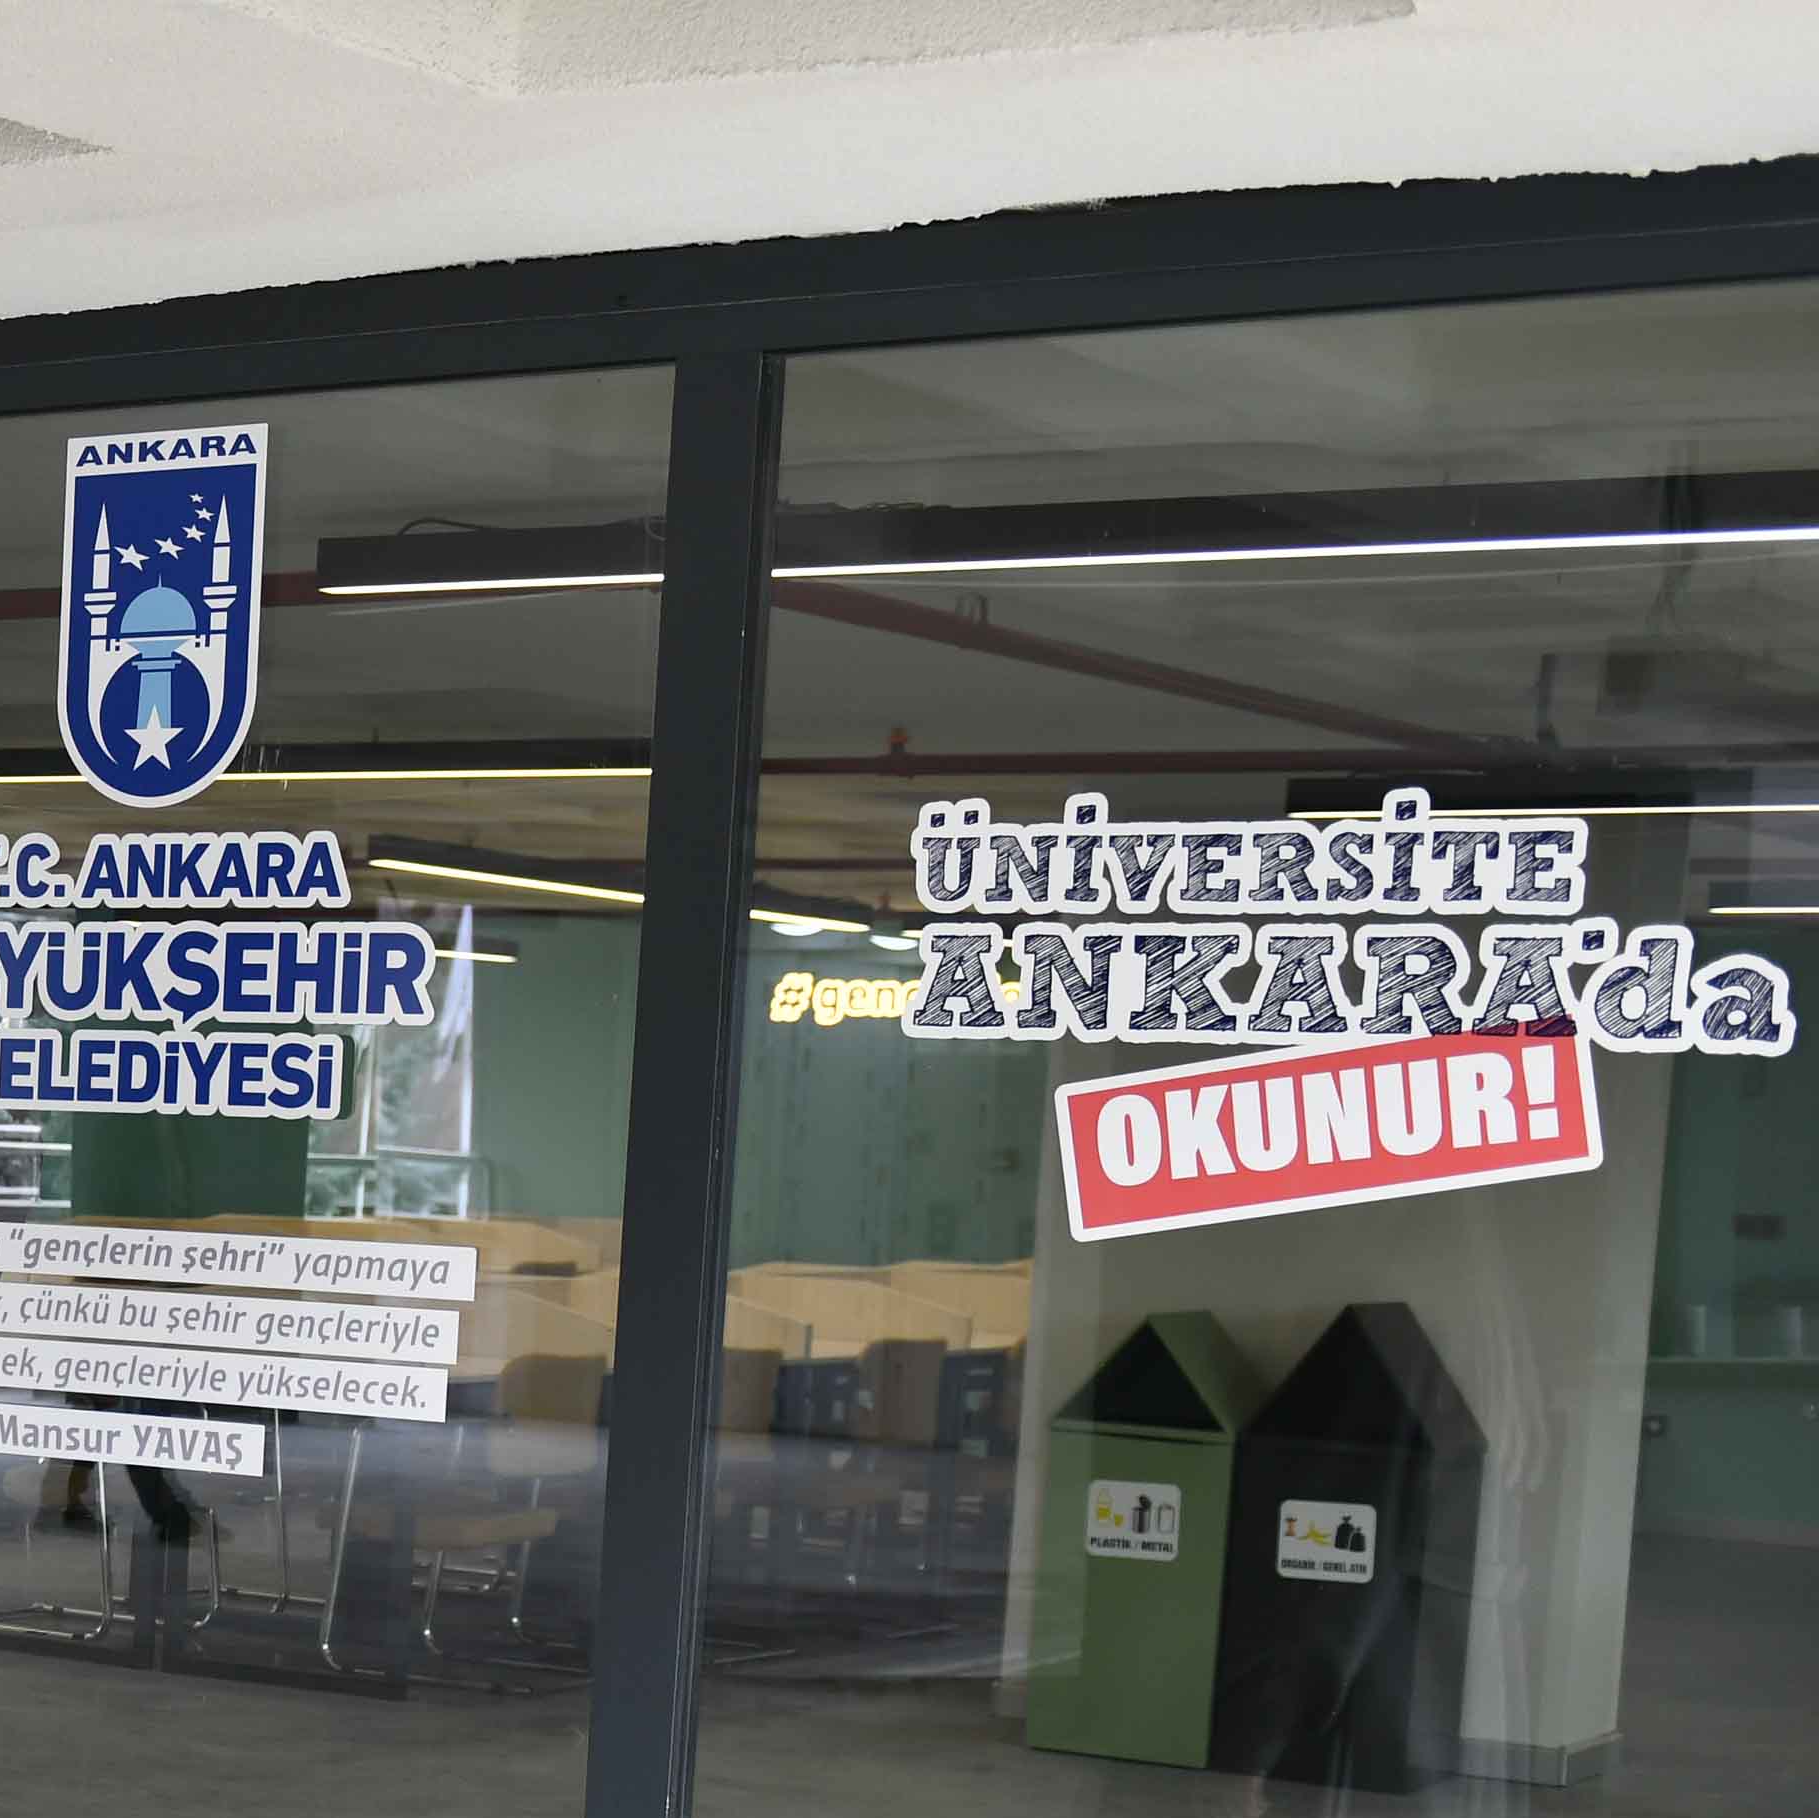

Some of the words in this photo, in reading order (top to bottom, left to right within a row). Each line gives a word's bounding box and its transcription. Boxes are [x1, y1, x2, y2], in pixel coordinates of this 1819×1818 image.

[74, 432, 258, 469] ANKARA
[82, 840, 343, 900] ANKARA
[919, 796, 1577, 905] ÜNİVERSİTE
[911, 927, 1783, 1044] ANKARA'da
[1094, 1042, 1561, 1188] OKUNUR!
[10, 1227, 173, 1269] "gençlerin
[181, 1240, 284, 1274] şehri"
[293, 1250, 451, 1290] yapmaya
[19, 1290, 111, 1325] çünkü
[119, 1295, 158, 1328] bu
[166, 1301, 247, 1334] şehir
[254, 1309, 440, 1354] gençleriyle
[54, 1353, 227, 1397] gençleriyle
[238, 1364, 427, 1410] yükselecek.
[133, 1423, 244, 1471] YAVAŞ
